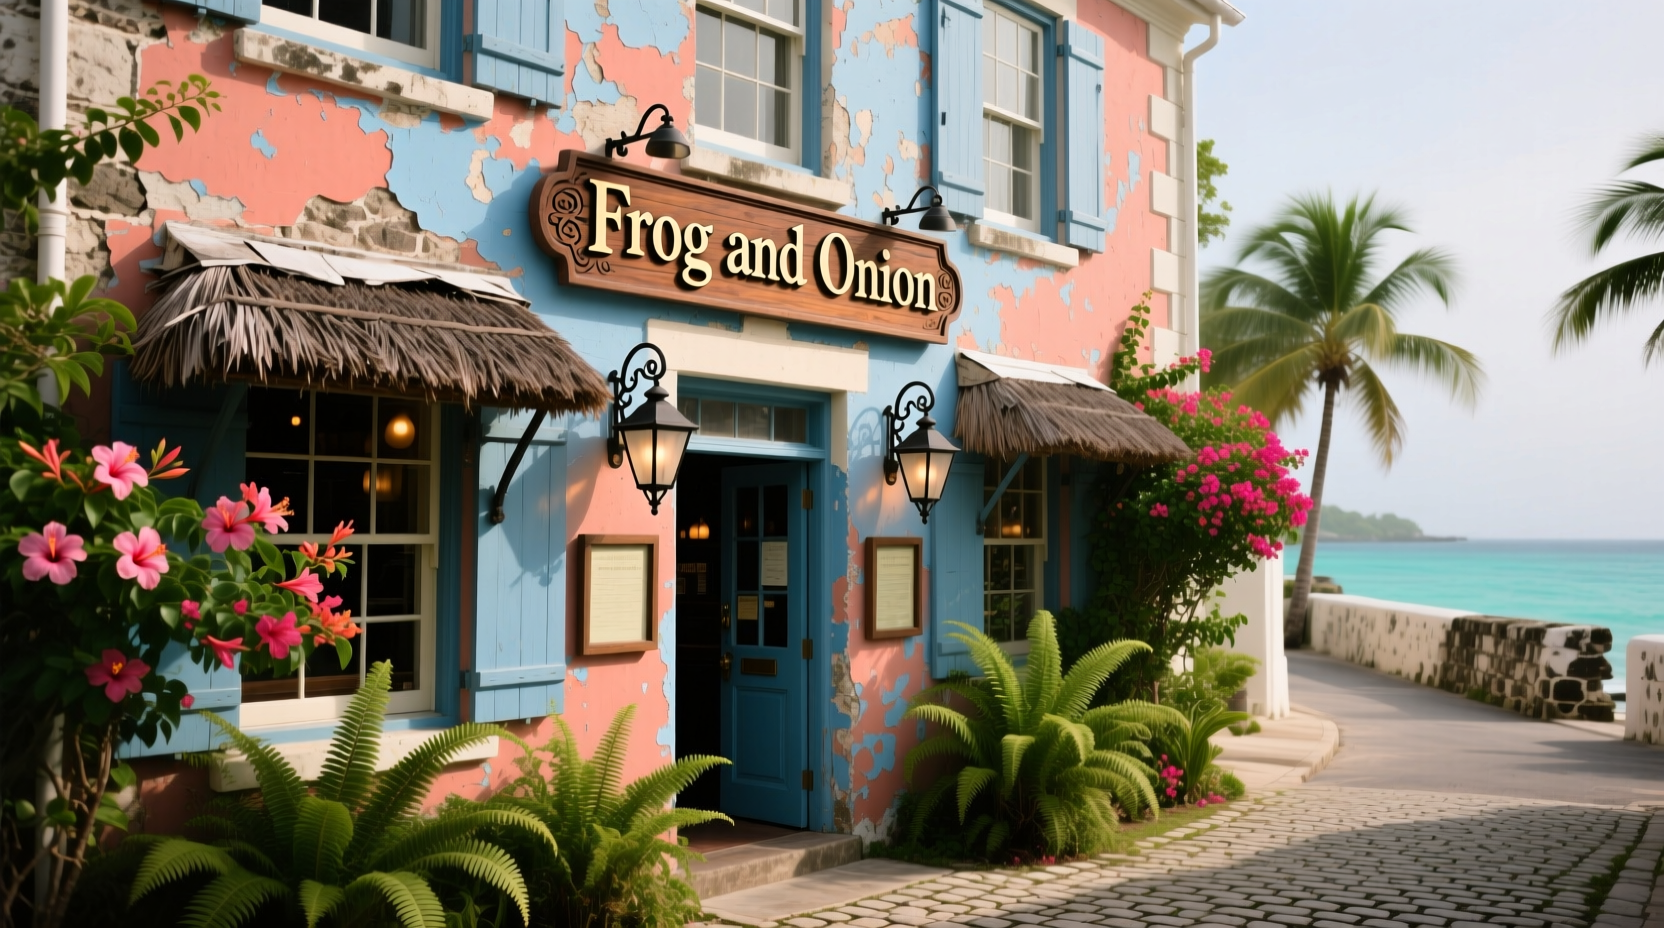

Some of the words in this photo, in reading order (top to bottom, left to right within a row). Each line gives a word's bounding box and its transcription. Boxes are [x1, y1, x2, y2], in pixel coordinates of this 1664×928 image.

[588, 178, 714, 287] Frog
[726, 224, 808, 286] and
[819, 232, 939, 311] Onion
